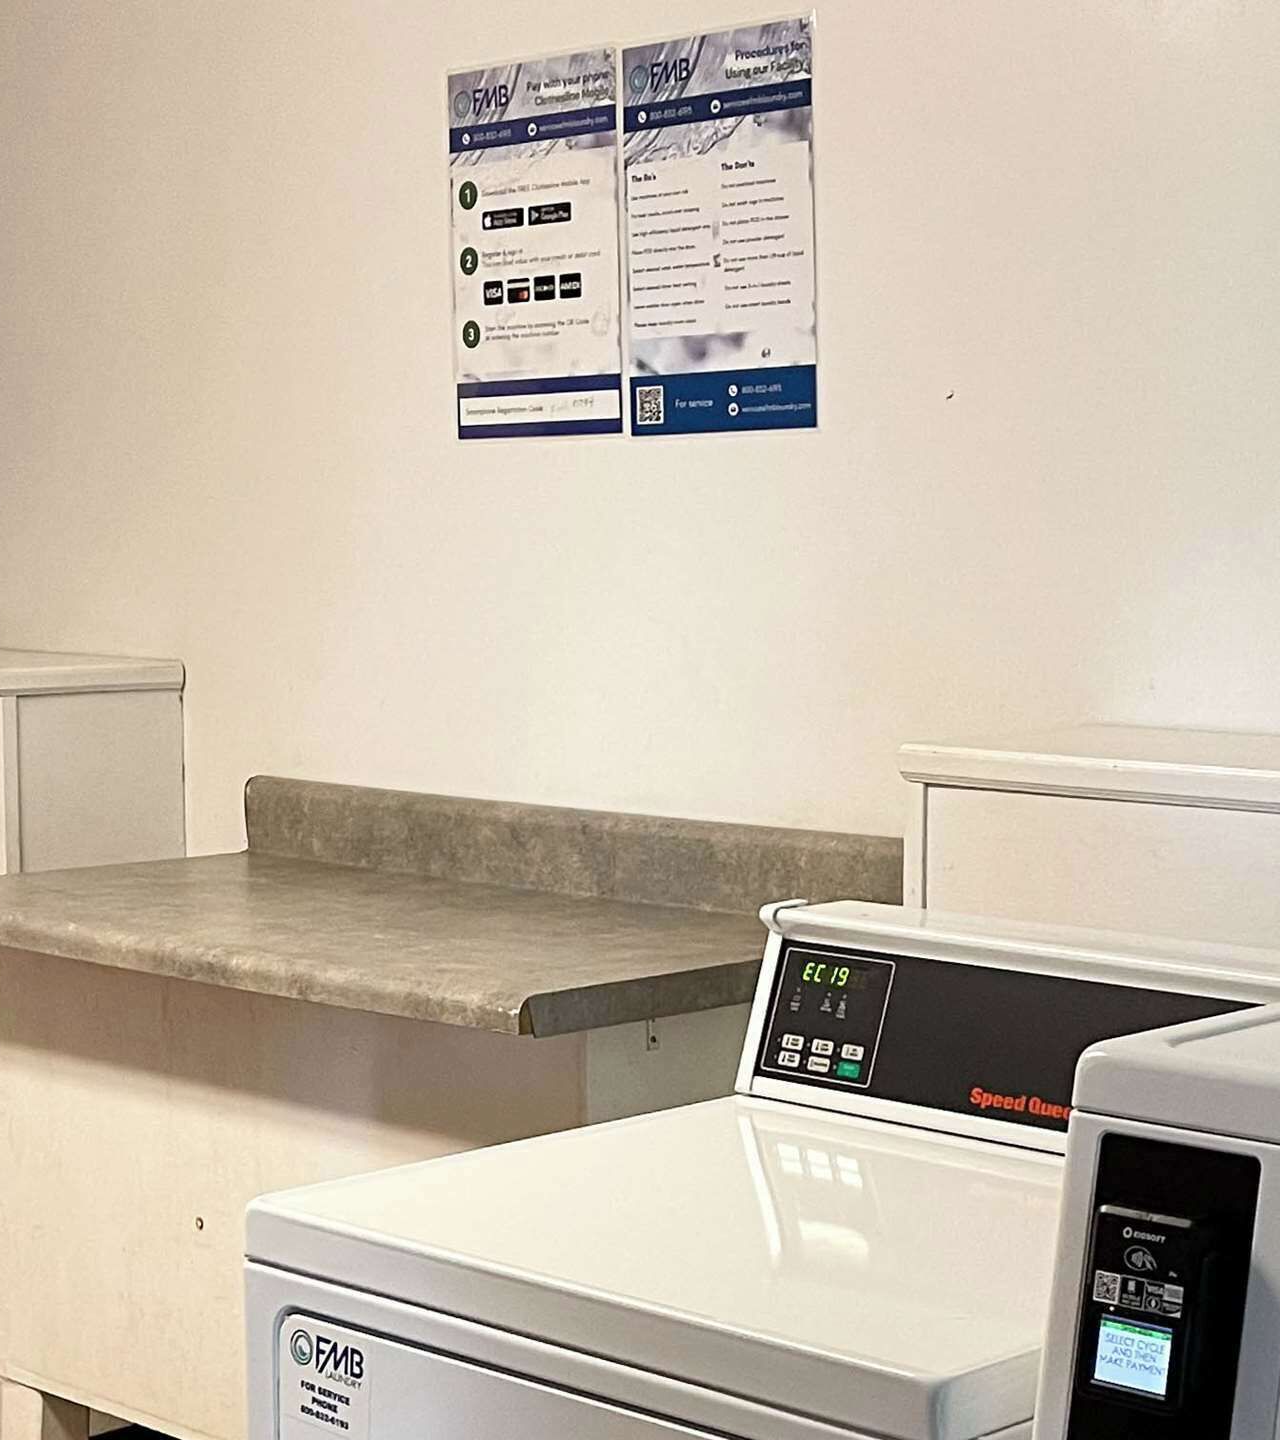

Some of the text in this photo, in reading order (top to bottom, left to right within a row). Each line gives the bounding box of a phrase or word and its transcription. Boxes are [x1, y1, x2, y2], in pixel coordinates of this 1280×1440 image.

[735, 40, 806, 60] Procedures for
[650, 58, 690, 92] FMB
[725, 67, 751, 80] Using
[752, 64, 768, 75] our
[526, 81, 541, 93] Pay
[472, 85, 510, 117] FMB
[970, 1087, 1026, 1112] Speed
[315, 1335, 364, 1379] FMB
[1136, 1338, 1166, 1354] CYCLE
[300, 1380, 350, 1406] FOR SERVICE
[312, 1396, 338, 1413] PHONE
